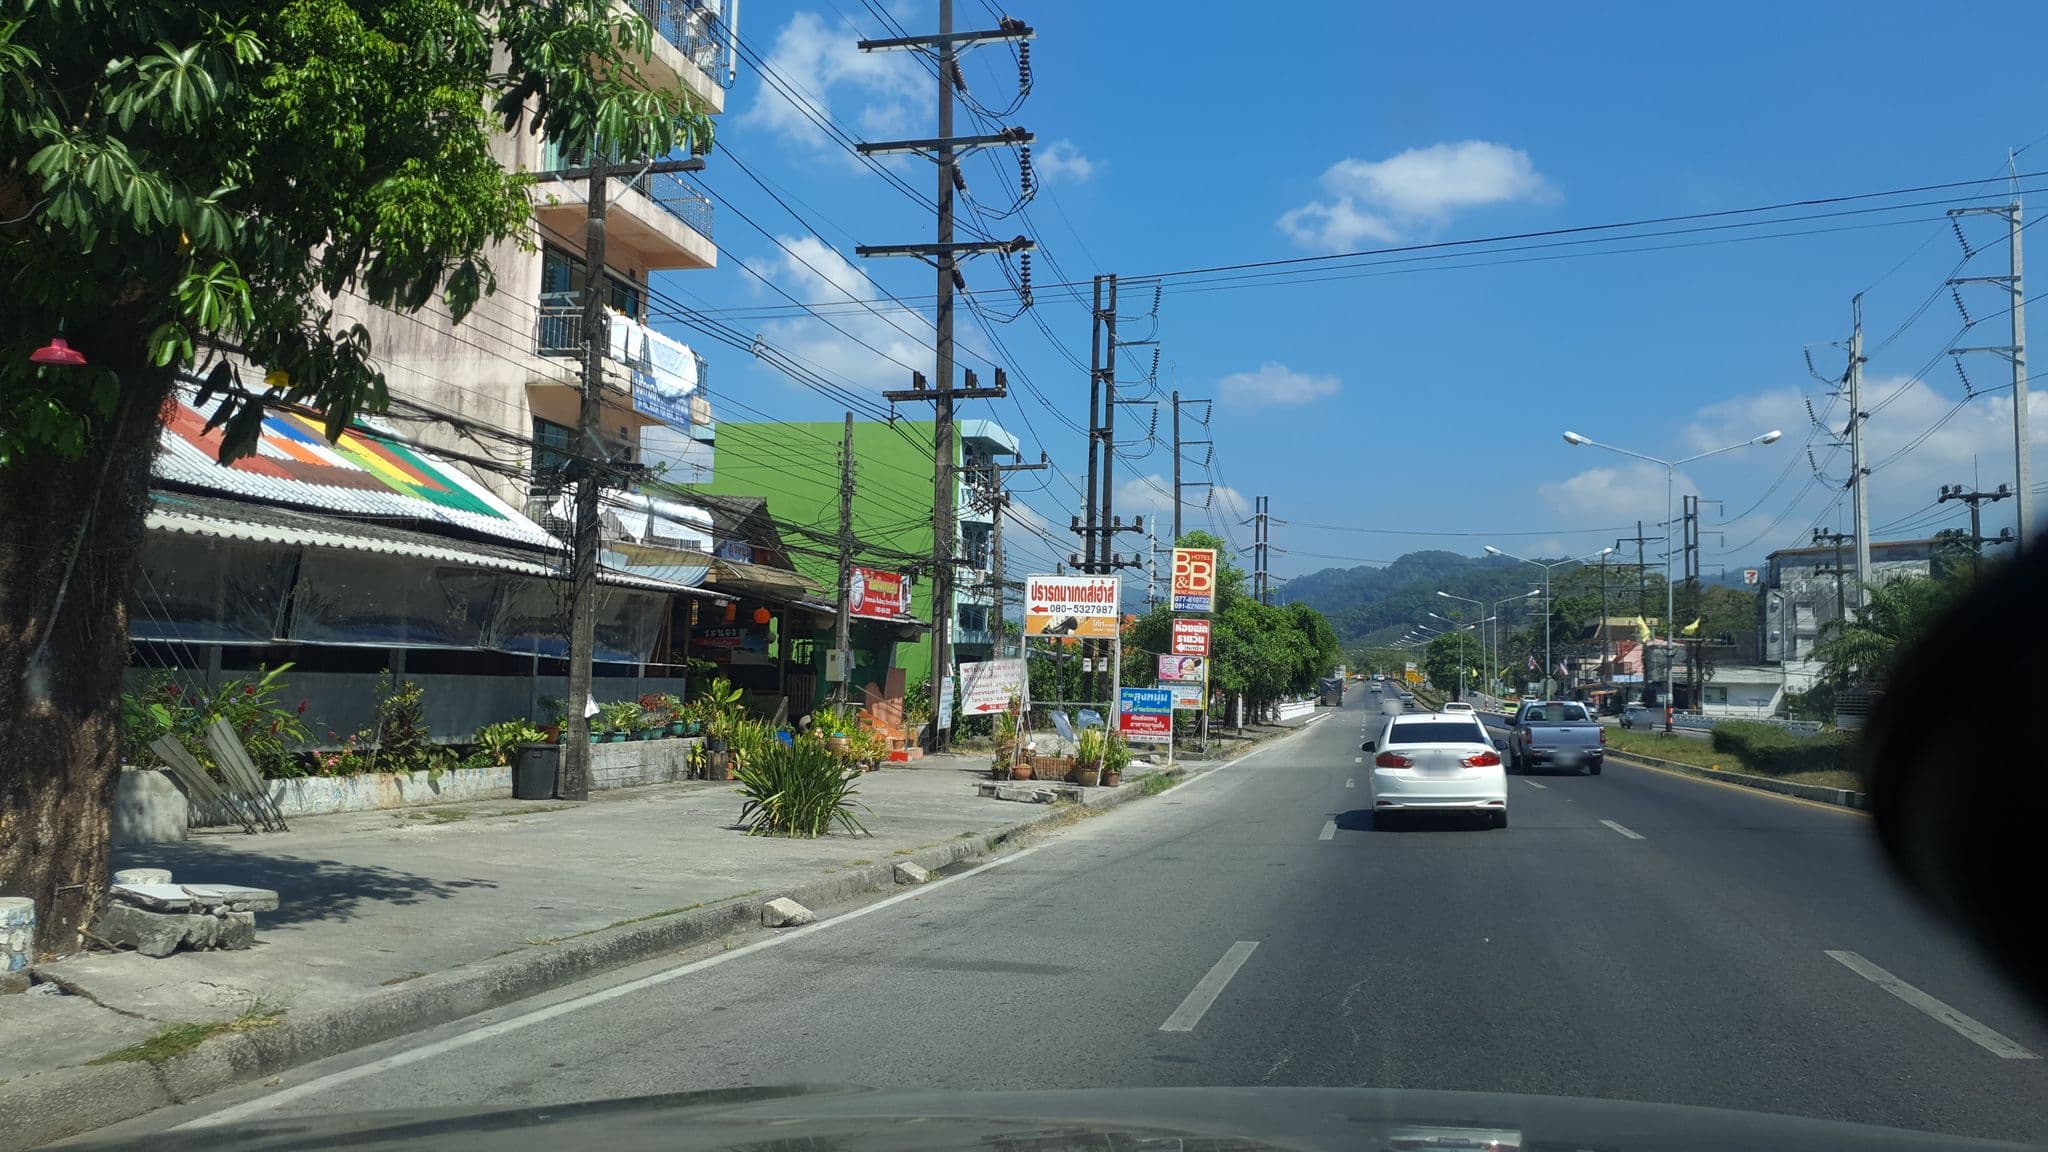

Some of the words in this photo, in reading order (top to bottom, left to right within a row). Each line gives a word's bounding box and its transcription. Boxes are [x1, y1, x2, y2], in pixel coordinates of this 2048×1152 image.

[1175, 552, 1190, 576] B
[1190, 561, 1211, 591] B
[1049, 604, 1114, 614] 080-5327987
[1175, 621, 1208, 633] ห้องพัก
[1177, 633, 1205, 644] รายวัน
